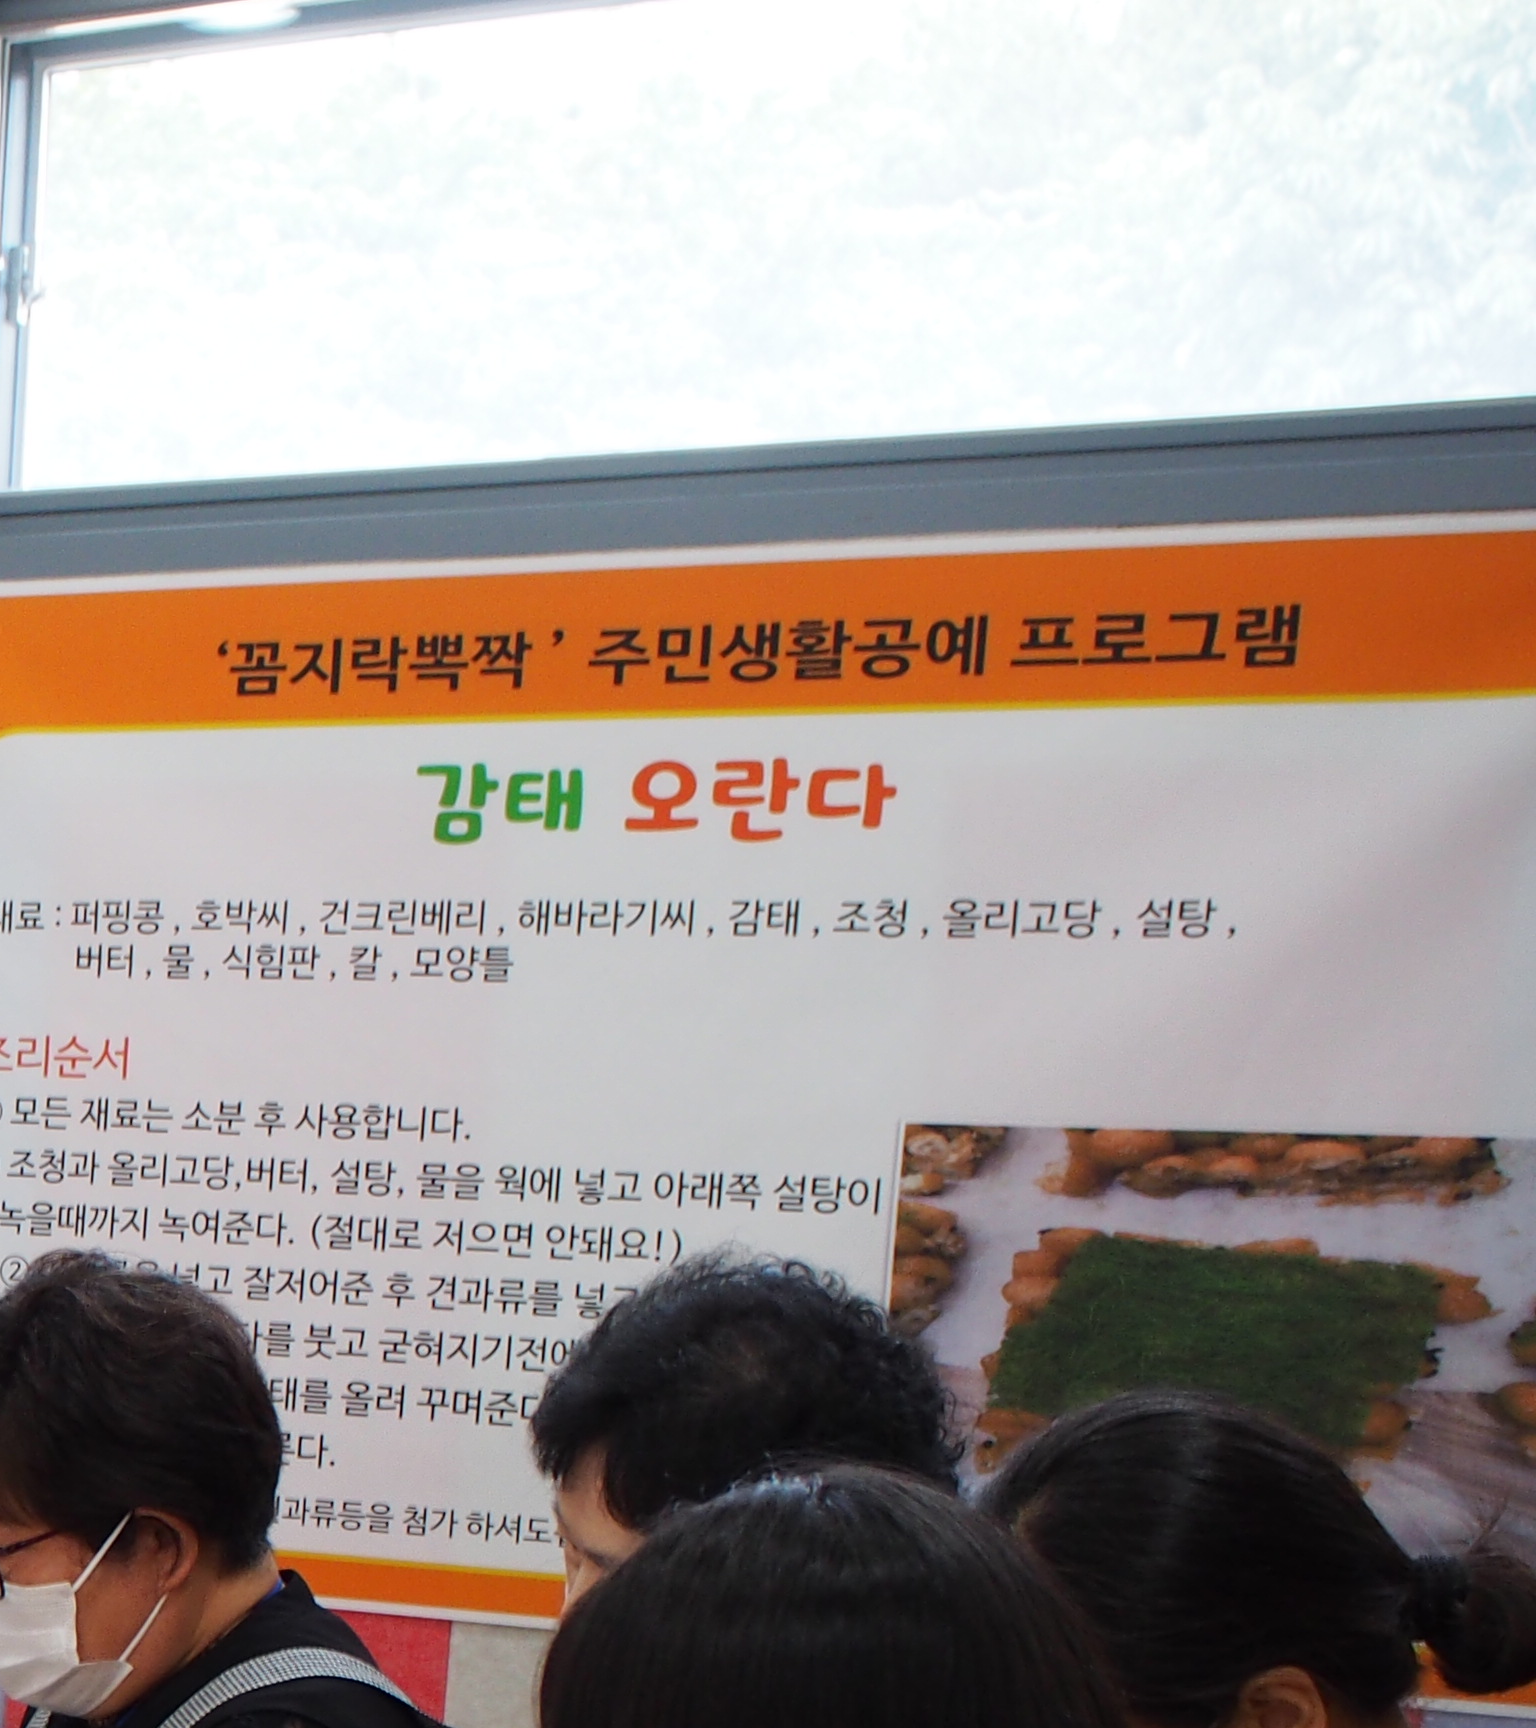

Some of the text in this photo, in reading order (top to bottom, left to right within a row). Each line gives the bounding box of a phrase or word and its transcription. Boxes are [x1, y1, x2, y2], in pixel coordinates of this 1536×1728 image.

[588, 614, 989, 686] 주민생활공예
[1009, 603, 1302, 669] 프로그램
[416, 757, 898, 844] 감태 오란다
[410, 945, 514, 983] 모양틀
[10, 1097, 73, 1129] 모든
[80, 1098, 174, 1134] 재료는
[181, 1100, 246, 1136] 소분
[253, 1101, 286, 1137] 후
[294, 1103, 472, 1143] 사용합니다.
[6, 1149, 100, 1186] 조청과
[329, 1158, 405, 1199] 설탕,
[416, 1162, 485, 1200] 물을
[494, 1164, 562, 1204] 웍에
[574, 1168, 642, 1205] 넣고
[653, 1170, 763, 1211] 아래쪽
[772, 1174, 883, 1216] 설탕이
[158, 1207, 295, 1247] 녹여준다.
[311, 1213, 423, 1252] (절대로
[432, 1219, 534, 1260] 저으면
[545, 1223, 685, 1265] 안돼요!)
[243, 1266, 374, 1307] 잘저어준
[382, 1271, 415, 1309] 후
[427, 1274, 564, 1318] 견과류를
[303, 1322, 369, 1361] 붓고
[340, 1380, 406, 1420] 올려
[274, 1495, 565, 1548] 과류등을 첨가 하셔도
